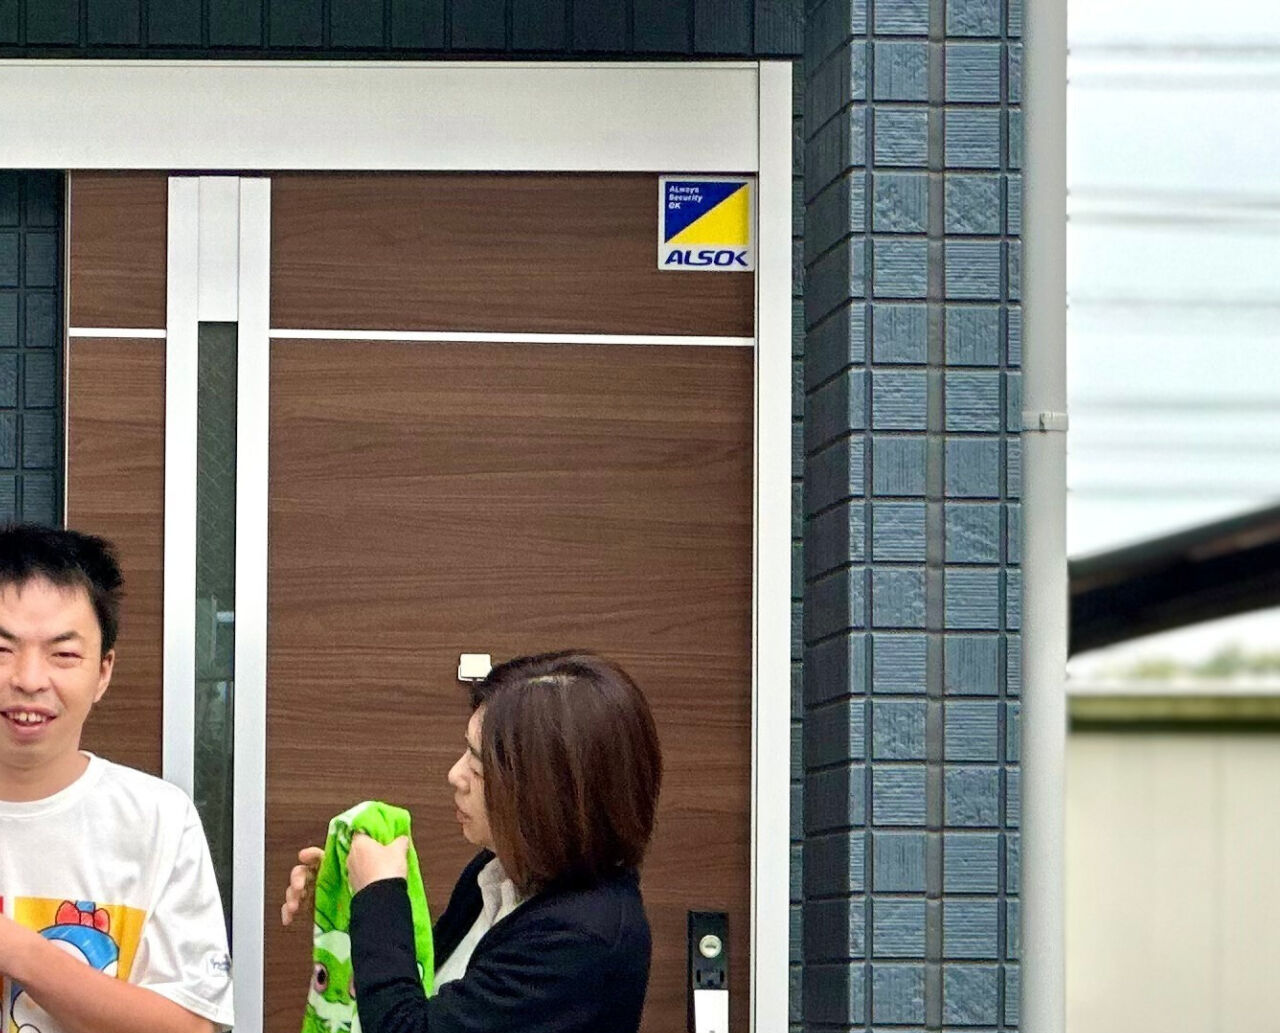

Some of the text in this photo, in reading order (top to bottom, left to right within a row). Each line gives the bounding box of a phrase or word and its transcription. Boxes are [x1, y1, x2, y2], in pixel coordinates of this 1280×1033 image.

[668, 194, 703, 203] Security
[668, 202, 681, 210] OK
[664, 249, 749, 267] ALSOK
